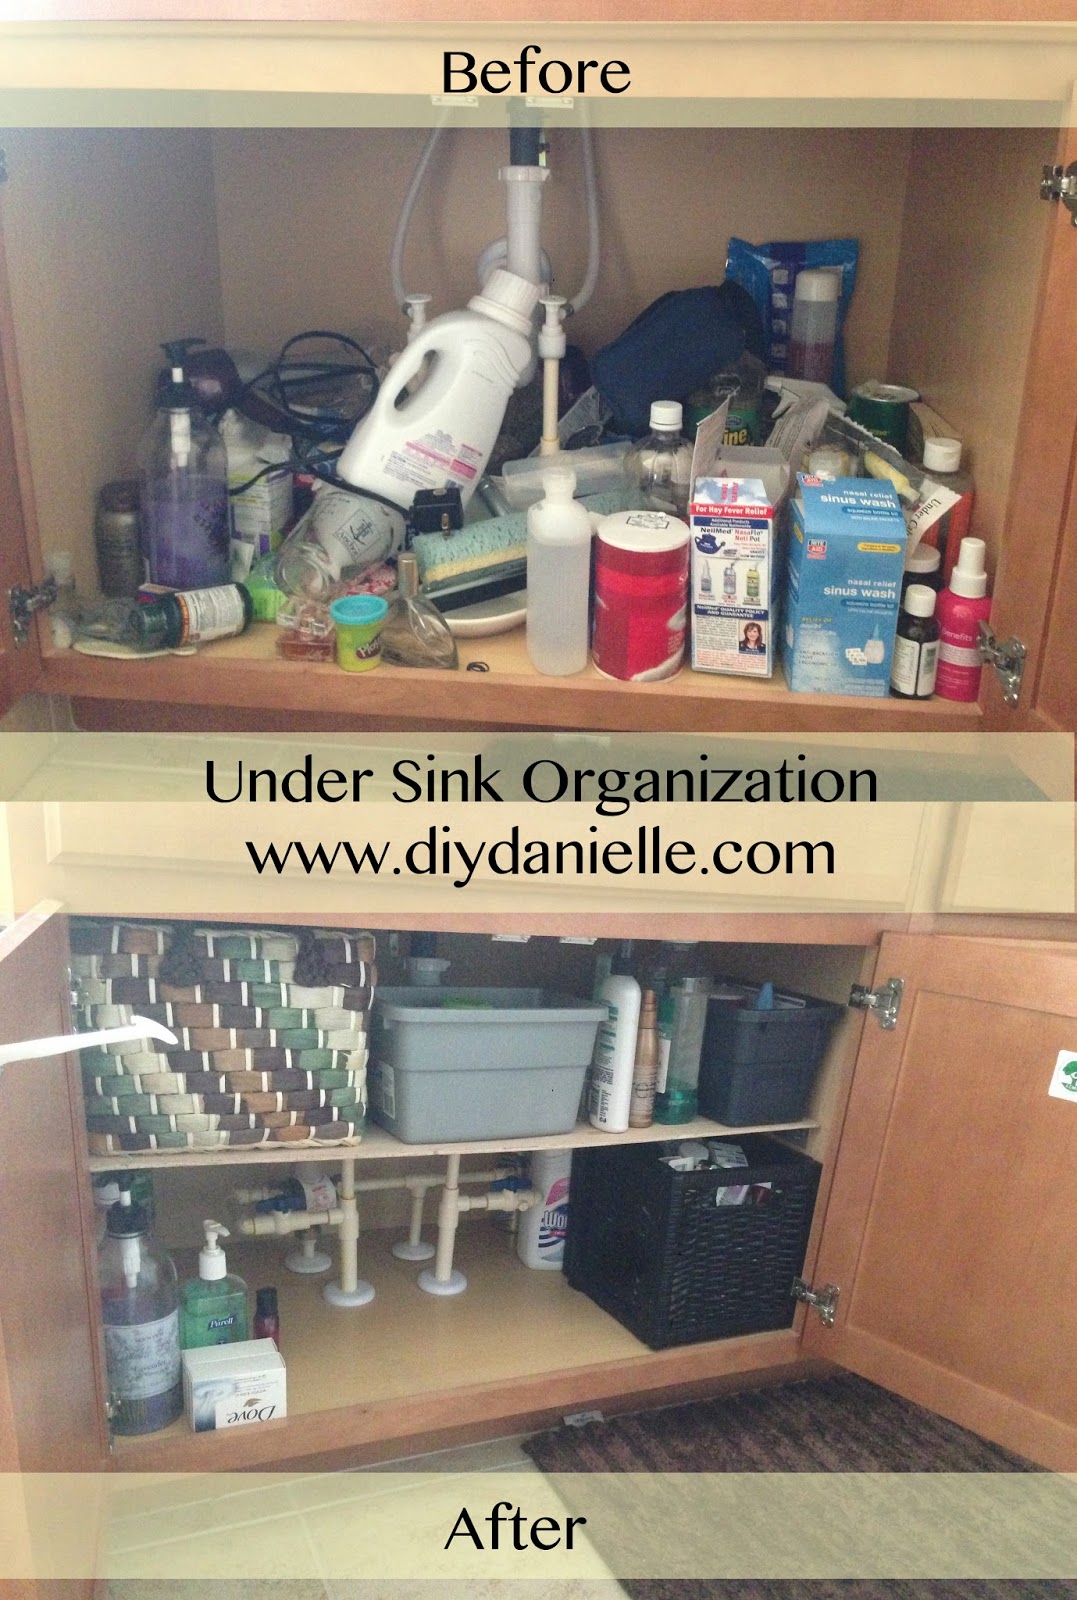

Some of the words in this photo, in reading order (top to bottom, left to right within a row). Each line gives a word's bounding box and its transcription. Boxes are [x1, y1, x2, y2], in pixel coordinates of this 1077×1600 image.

[820, 494, 856, 505] sinus
[860, 498, 896, 508] wash
[696, 505, 707, 513] For
[709, 506, 722, 515] Hay
[724, 506, 743, 514] Fever
[745, 507, 767, 515] Relief
[915, 498, 942, 519] Under
[823, 586, 857, 596] sinus
[861, 589, 896, 599] wash
[227, 1405, 276, 1424] Dove
